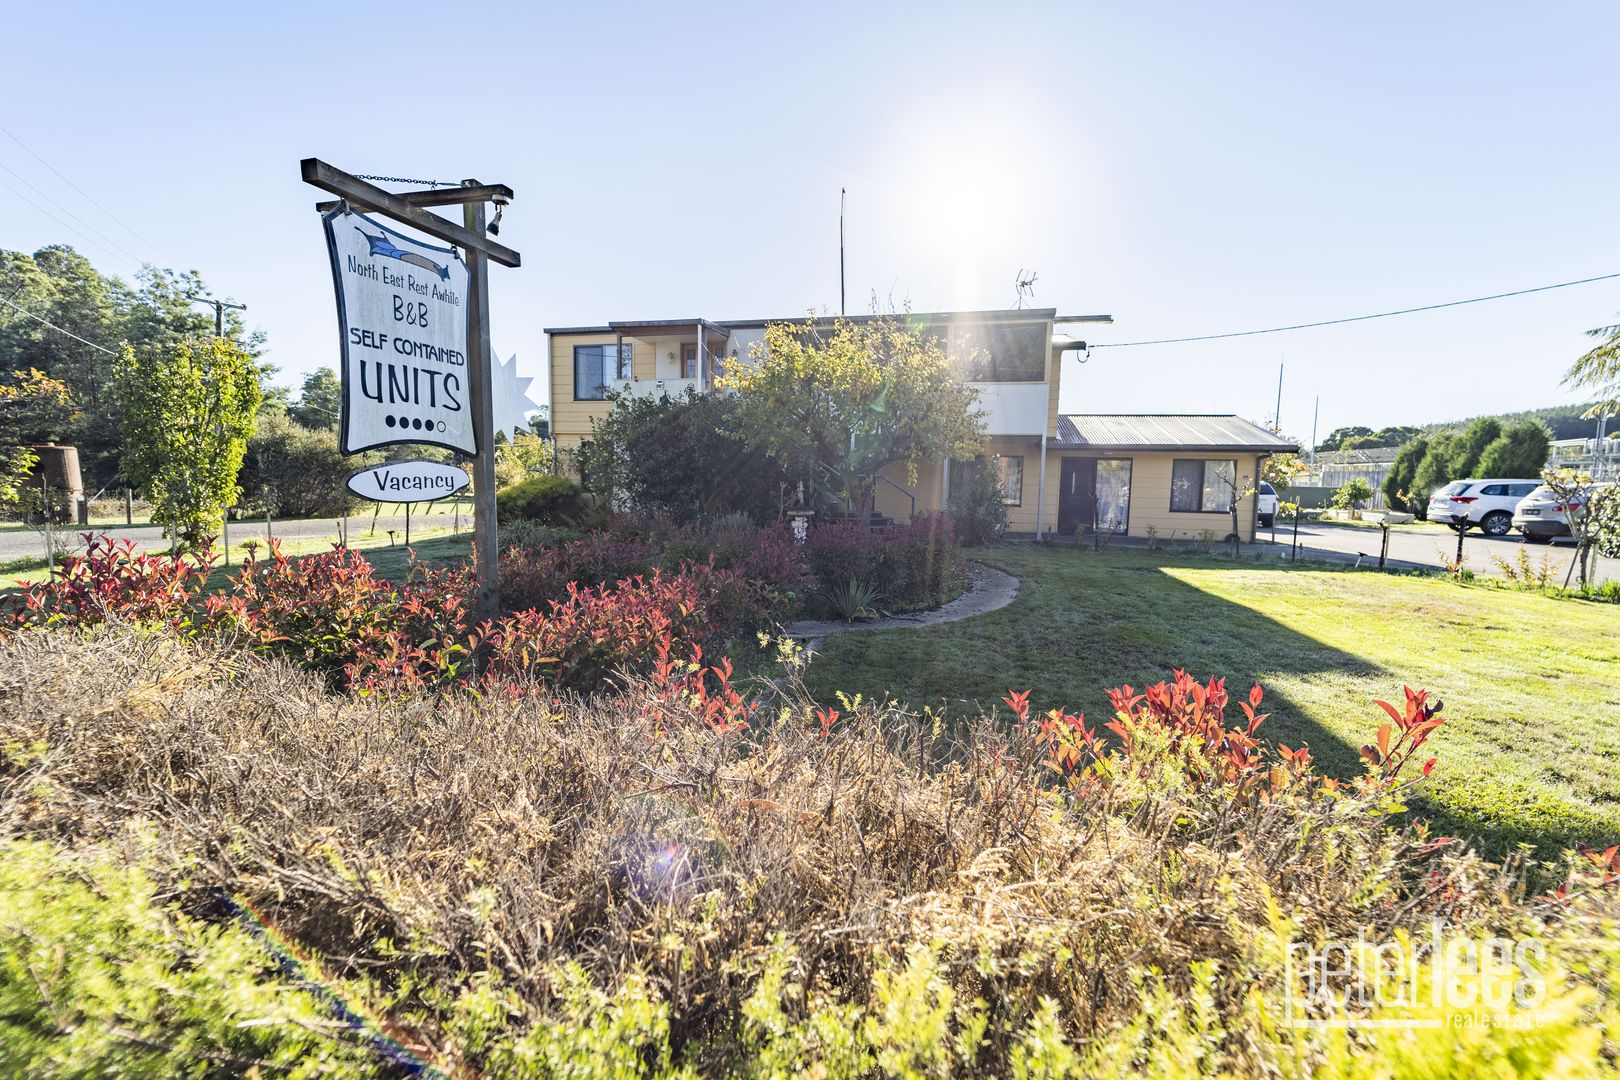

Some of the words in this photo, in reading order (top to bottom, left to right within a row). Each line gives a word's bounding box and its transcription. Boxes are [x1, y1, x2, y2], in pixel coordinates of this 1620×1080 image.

[348, 254, 378, 281] North
[383, 266, 404, 288] East
[408, 274, 429, 296] Rest
[432, 284, 460, 307] Awhile
[392, 294, 428, 328] B&B
[350, 327, 387, 350] SELF
[393, 337, 465, 367] CONTAINED
[360, 359, 461, 412] UNITS
[373, 470, 454, 492] Vacancy
